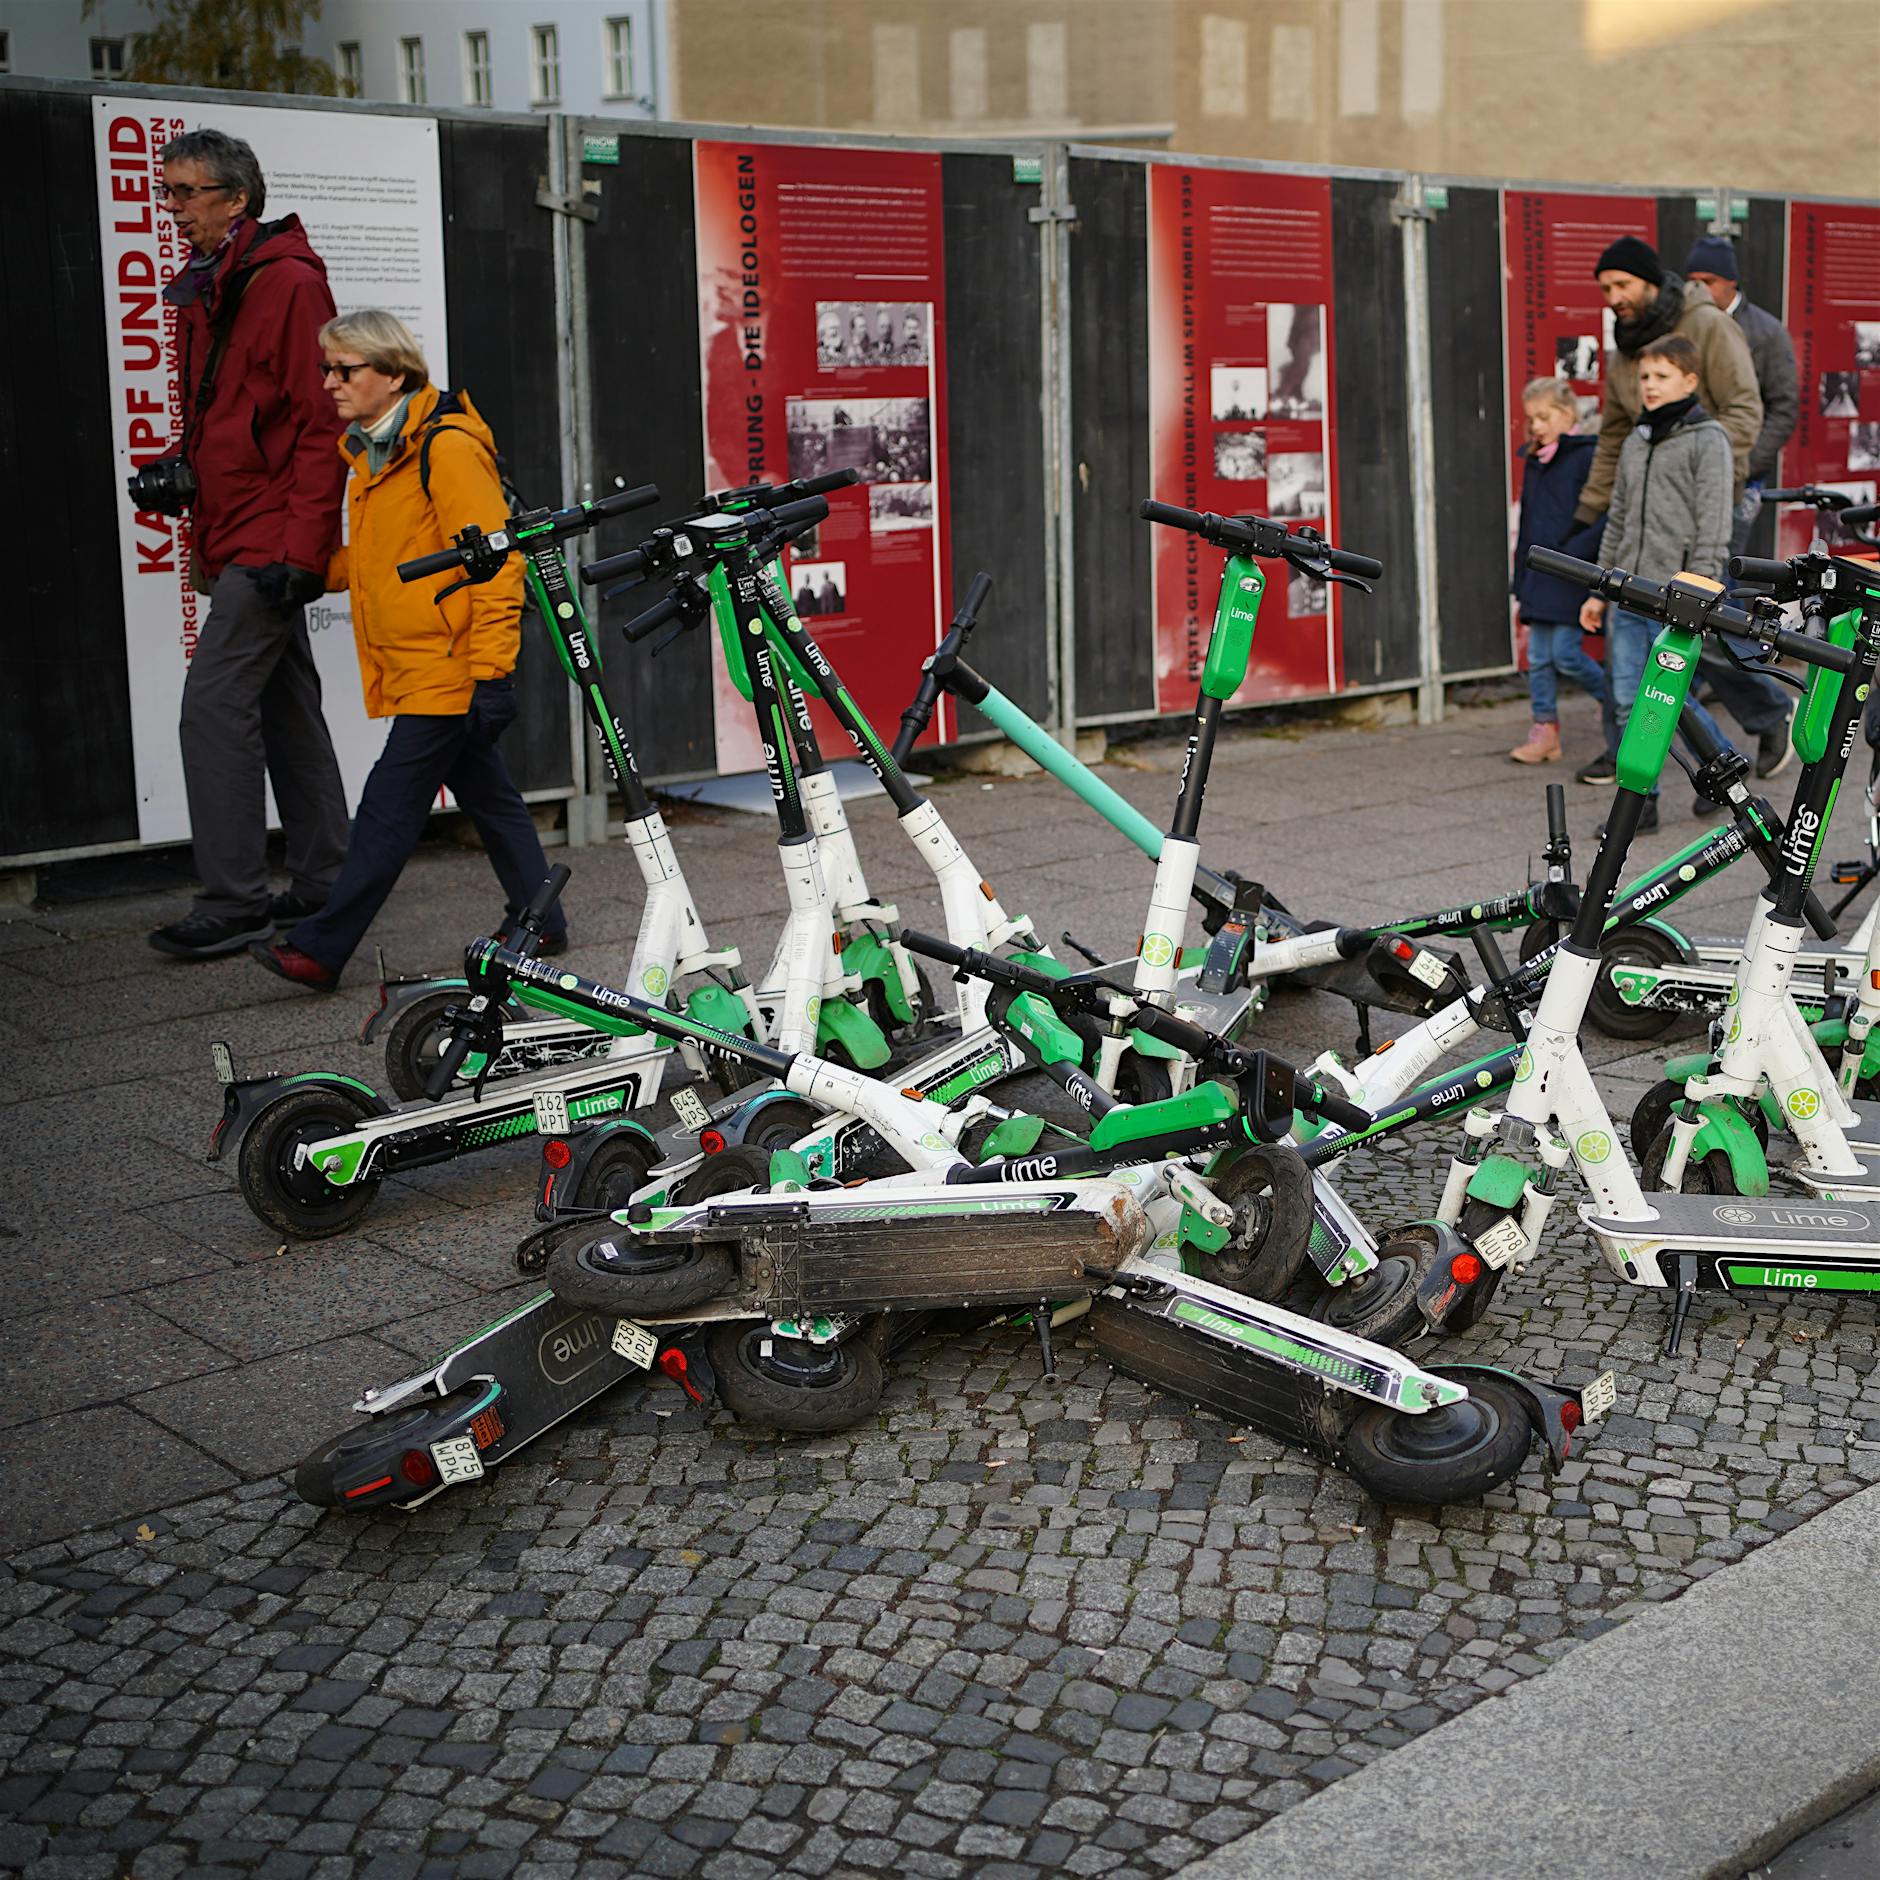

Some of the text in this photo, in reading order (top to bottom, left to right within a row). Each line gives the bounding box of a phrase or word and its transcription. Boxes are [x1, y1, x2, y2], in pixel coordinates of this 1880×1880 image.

[109, 116, 153, 234] LEID
[1182, 174, 1193, 220] 1939
[157, 219, 174, 260] DES
[738, 153, 761, 319] IDEOLOGEN
[1182, 225, 1194, 339] SEPTEMBER
[118, 250, 161, 371] UND
[742, 327, 762, 371] DIE
[1183, 343, 1195, 367] IM
[165, 375, 184, 446] ÜRGER
[1182, 371, 1197, 467] ÜBERFALL
[746, 395, 765, 484] PRUNG
[1231, 607, 1254, 622] Lime
[569, 631, 590, 669] Lime
[805, 641, 831, 677] Lime
[1185, 615, 1200, 683] ERSTES
[757, 649, 773, 688] Lime
[1645, 685, 1676, 705] Lime
[1840, 719, 1860, 759] Lime
[1786, 811, 1820, 876] Lime
[1632, 883, 1671, 911] Lime
[1438, 910, 1464, 925] Lime
[592, 984, 630, 1008] Lime
[970, 1060, 1001, 1085] Lime
[537, 1095, 564, 1111] 162
[576, 1096, 620, 1118] Lime
[673, 1091, 697, 1111] 845
[1066, 1073, 1093, 1112] Lime
[1431, 1084, 1466, 1106] Lime
[539, 1114, 564, 1131] WPT
[682, 1107, 707, 1127] WPS
[981, 1199, 1041, 1212] Lime
[1770, 1209, 1850, 1228] Lime
[1479, 1234, 1507, 1263] WUY
[1496, 1222, 1523, 1252] 798
[1764, 1268, 1818, 1288] Lime
[553, 1315, 607, 1363] Lime
[615, 1324, 635, 1355] 738
[1198, 1312, 1245, 1338] Lime
[632, 1332, 654, 1366] WPU
[1585, 1384, 1600, 1418] WPK
[1599, 1375, 1615, 1406] 899
[435, 1445, 463, 1479] WPK
[455, 1441, 481, 1474] 875
